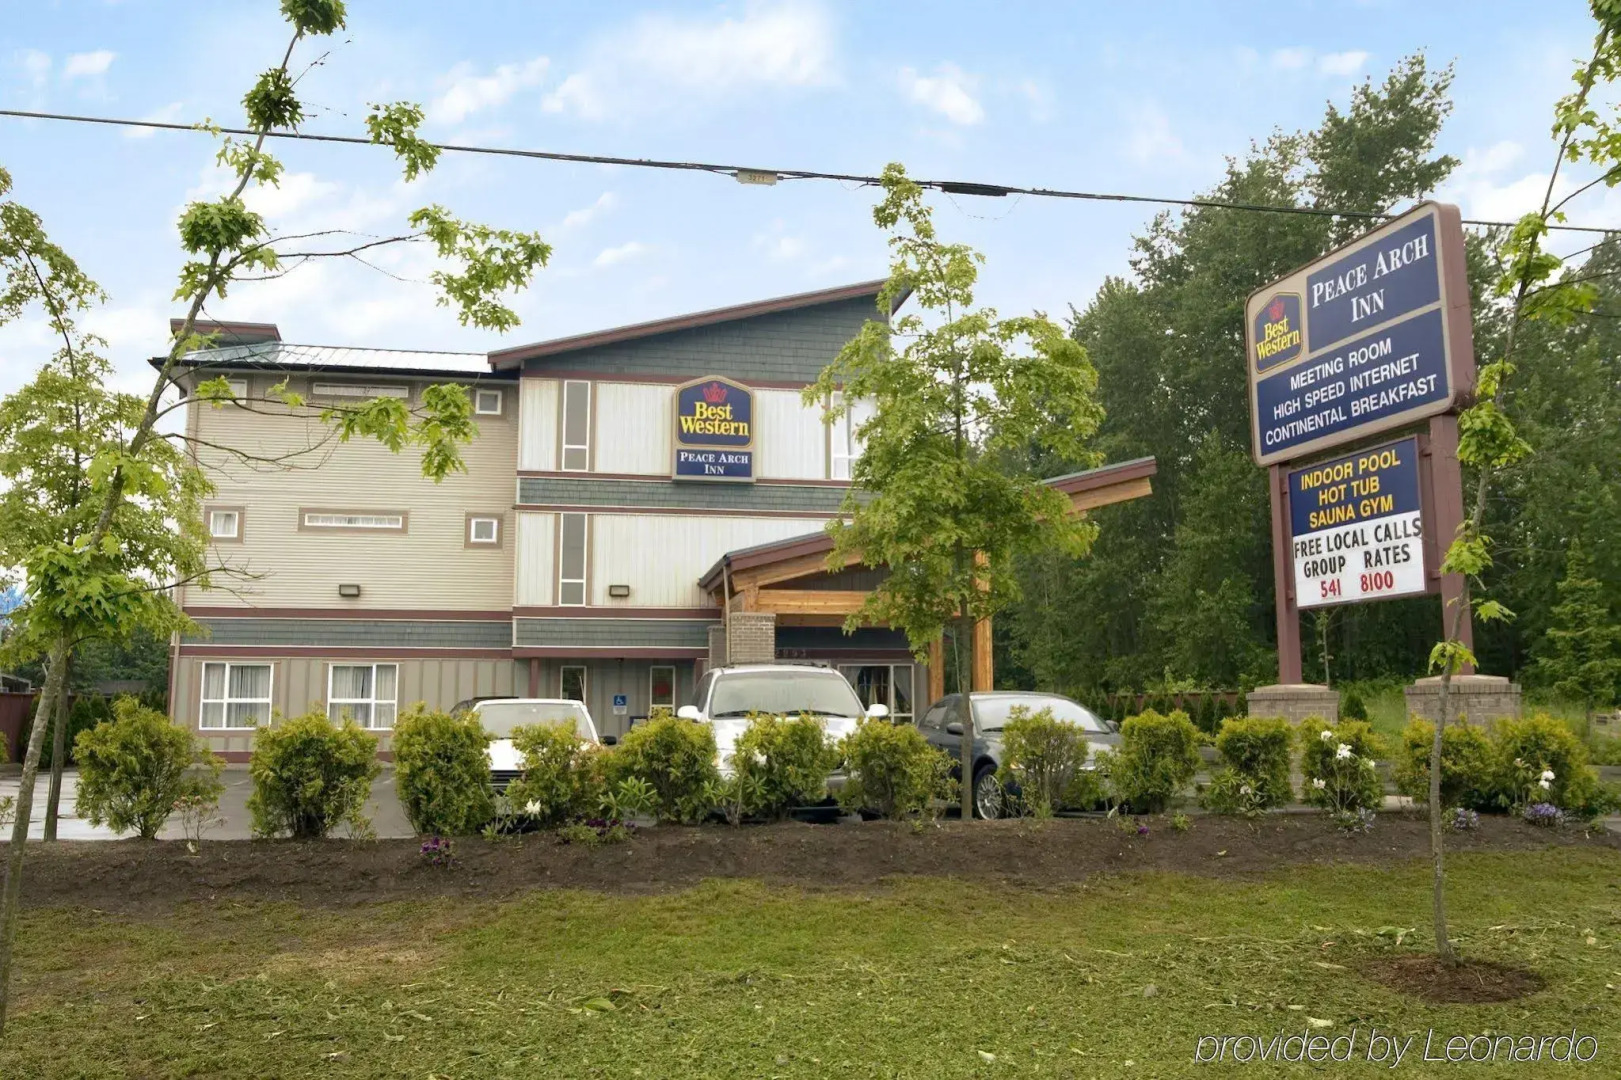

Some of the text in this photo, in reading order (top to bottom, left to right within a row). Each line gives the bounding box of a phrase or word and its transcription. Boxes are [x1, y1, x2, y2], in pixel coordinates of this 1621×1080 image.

[1256, 329, 1300, 360] Western
[1264, 316, 1289, 342] Best
[1290, 337, 1392, 391] MEETING ROOM
[1273, 353, 1419, 420] HIGH SPEED INTERNET
[680, 415, 749, 436] Western
[695, 401, 733, 420] Best
[1265, 374, 1437, 446] CONTINENTAL BREAKFAST
[1301, 449, 1401, 490] INDOOR POOL
[1319, 476, 1380, 506] HOT TUB
[1309, 494, 1394, 529] SAUNA GYM
[1294, 517, 1422, 559] FREE LOCAL CALLS
[1303, 543, 1411, 578] GROUP RATES
[1320, 570, 1394, 598] 541 8100
